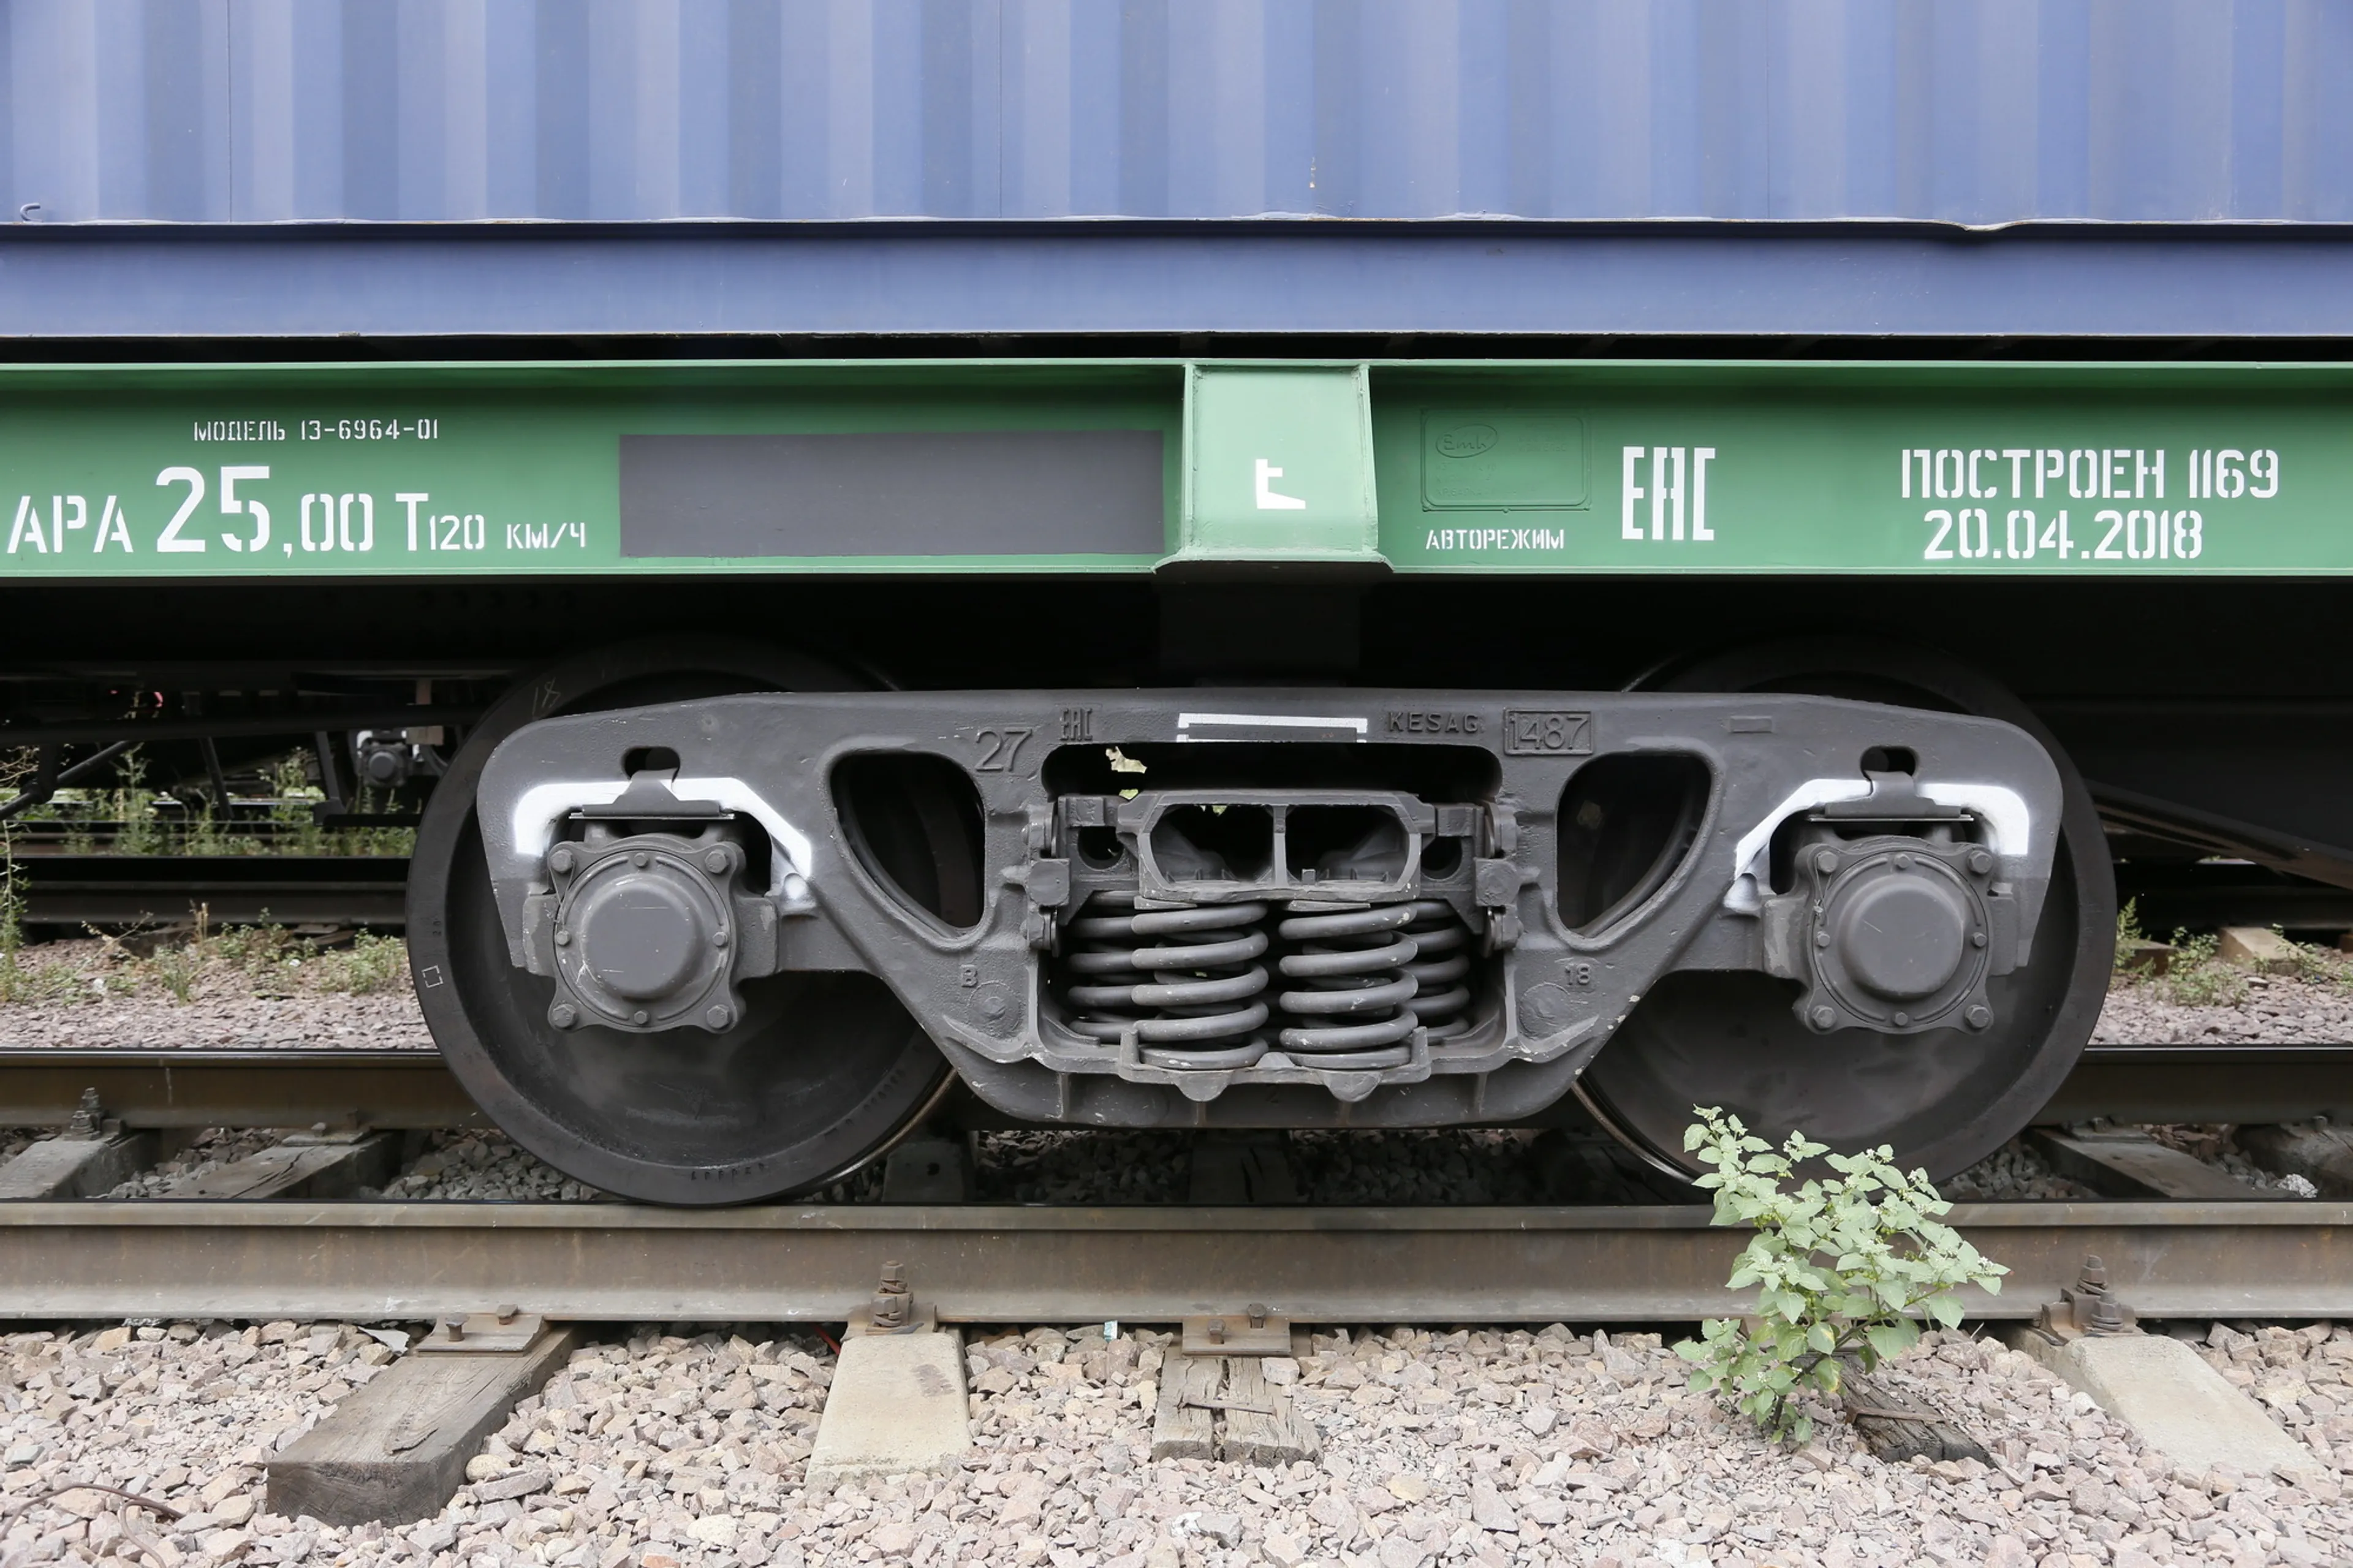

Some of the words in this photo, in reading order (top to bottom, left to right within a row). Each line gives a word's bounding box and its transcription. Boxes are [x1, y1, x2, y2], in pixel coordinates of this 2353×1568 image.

[194, 420, 286, 441] МОДЕЛЬ
[300, 419, 439, 441] 13-6964-01
[1901, 449, 2165, 499] ПОСТРОЕН
[2189, 449, 2279, 499] 1169
[155, 464, 374, 559] 25,00
[1923, 509, 2203, 560] 20.04.2018
[1425, 528, 1565, 550] АВТОРЕЖИМ
[975, 727, 1033, 773] 27
[1509, 713, 1589, 751] 1487
